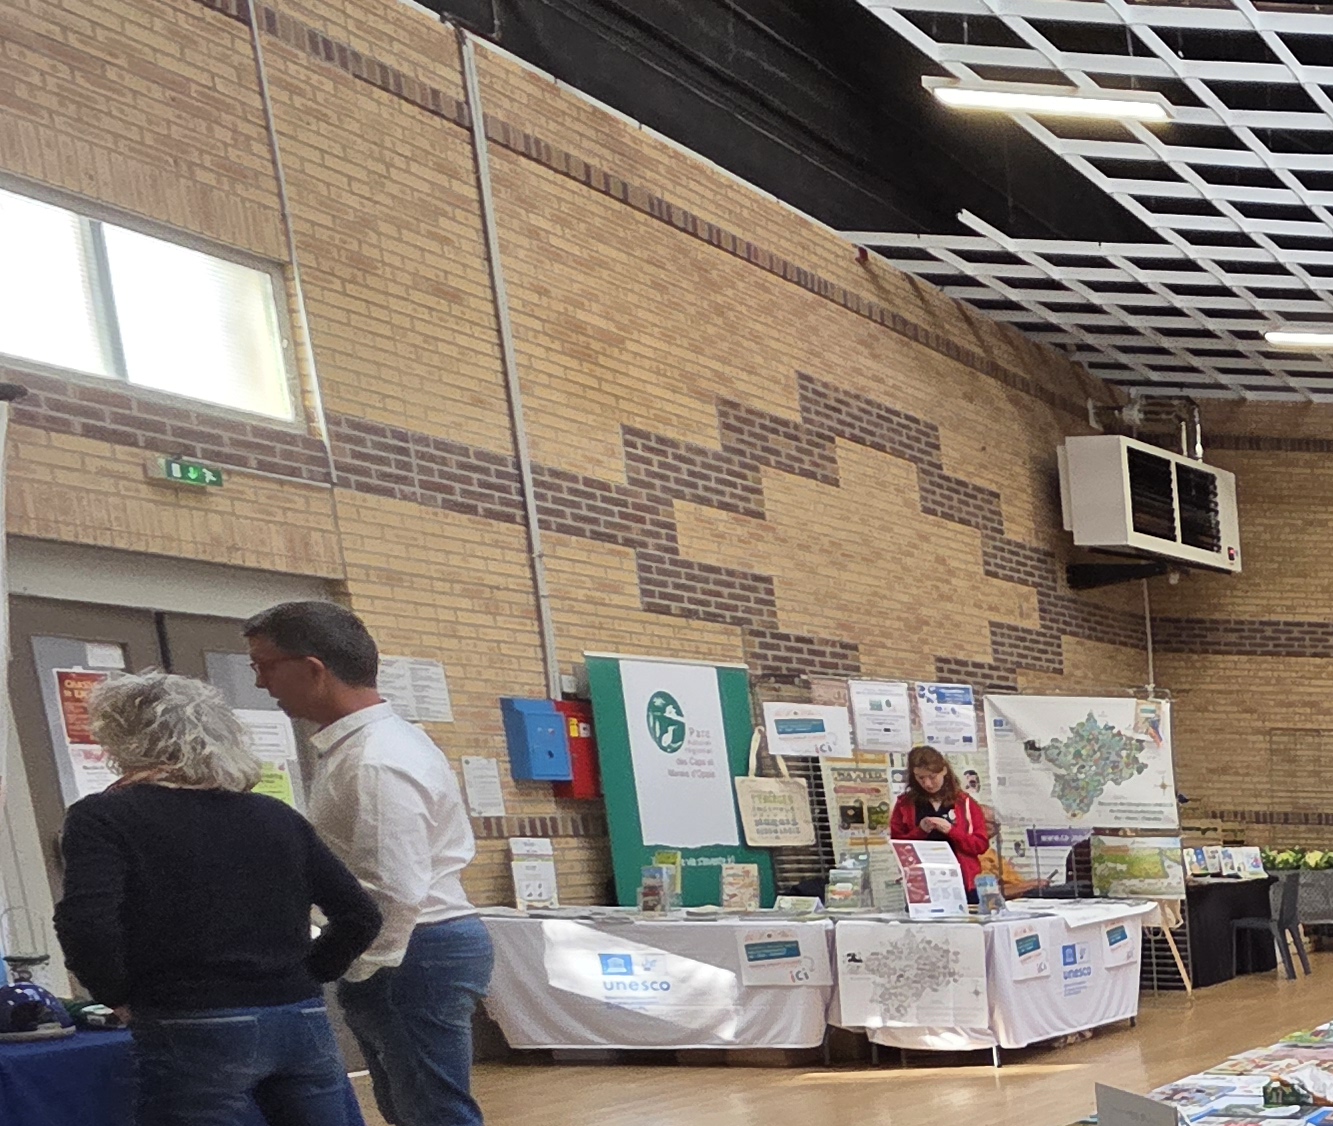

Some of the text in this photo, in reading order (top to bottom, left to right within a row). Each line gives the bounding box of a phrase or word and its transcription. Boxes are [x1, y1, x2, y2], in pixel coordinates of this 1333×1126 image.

[790, 968, 809, 983] ici
[1063, 967, 1091, 980] unesco
[603, 980, 671, 991] unesco
